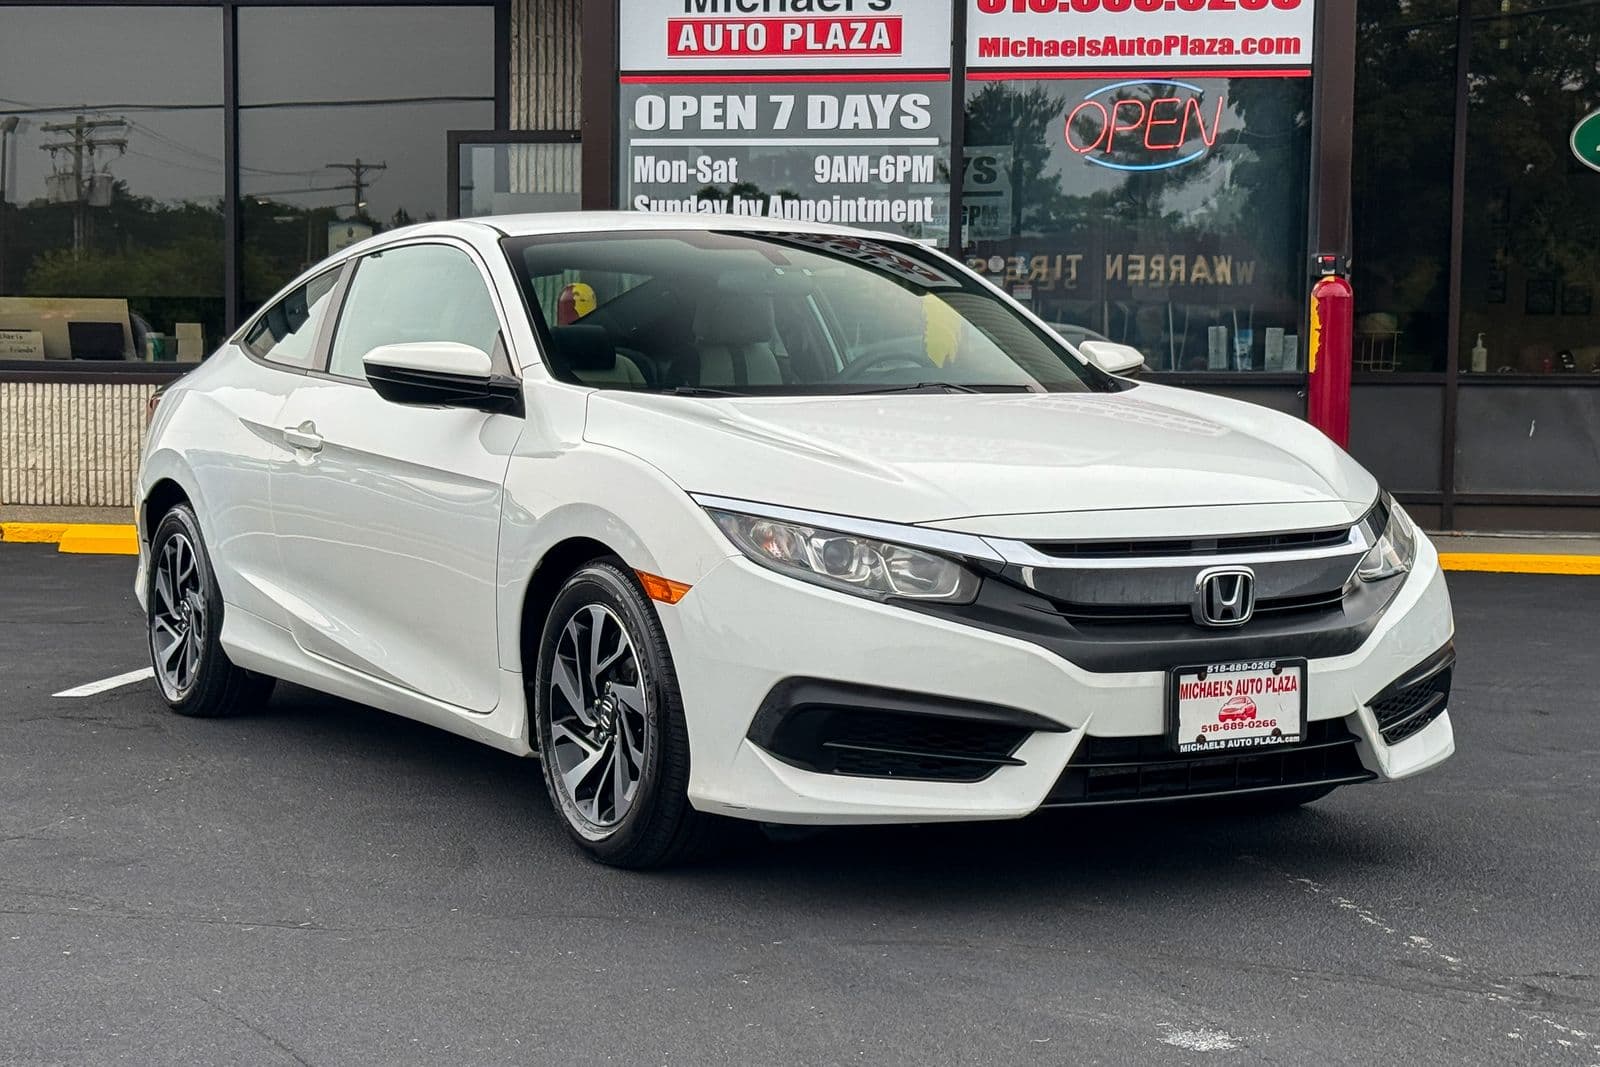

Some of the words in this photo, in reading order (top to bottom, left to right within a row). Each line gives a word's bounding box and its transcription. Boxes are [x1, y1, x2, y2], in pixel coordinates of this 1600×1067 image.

[677, 23, 767, 51] AUTO
[783, 22, 891, 50] PLAZA
[978, 35, 1301, 58] MichaelsAutoPlaza.com
[634, 95, 757, 131] OPEN
[769, 95, 795, 130] 7
[807, 93, 931, 130] DAYS
[1064, 96, 1223, 154] OPEN
[633, 155, 738, 184] Mon-Sat
[814, 154, 934, 184] 9AM-6PM
[767, 195, 933, 223] Appointment
[1207, 660, 1276, 673] 518-689-0266
[1180, 677, 1233, 699] MICHAEL'S
[1235, 678, 1263, 695] AUTO
[1265, 675, 1298, 692] PLAZA
[1201, 719, 1277, 733] 518-689-0266
[1227, 739, 1252, 747] AUTO
